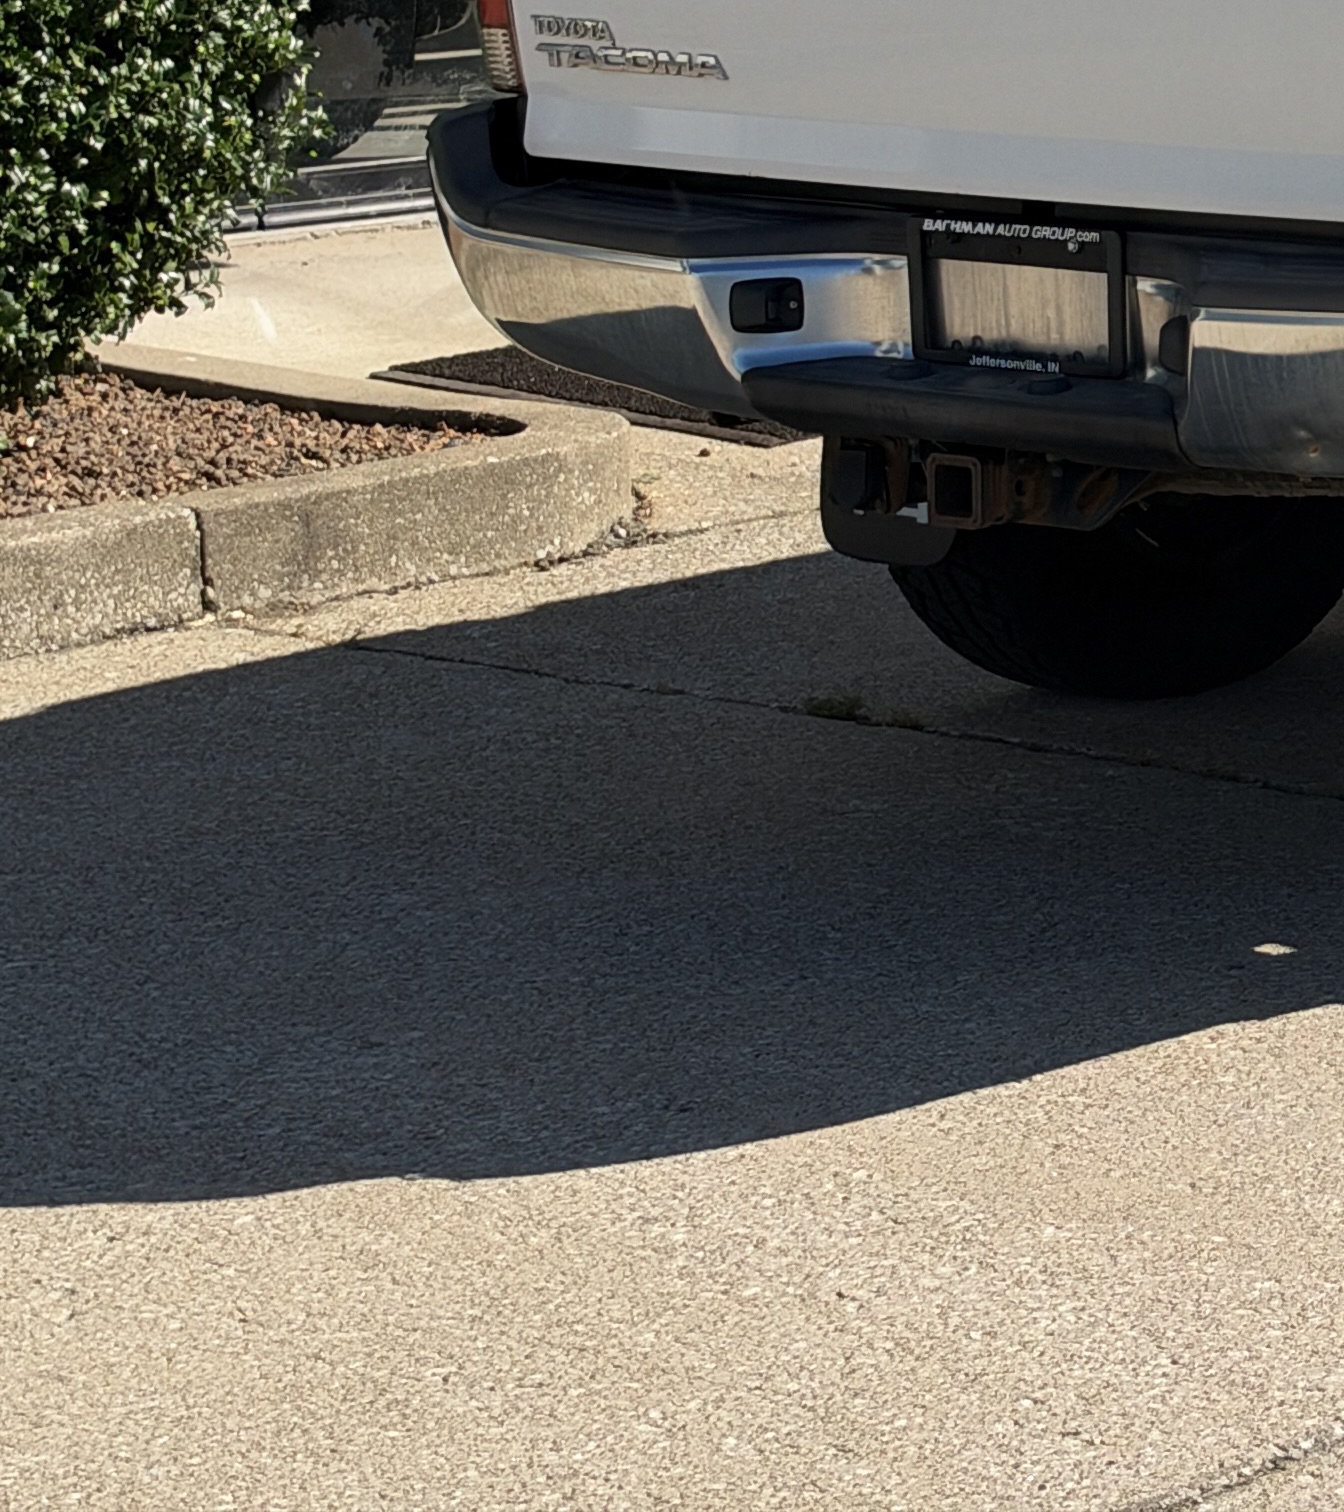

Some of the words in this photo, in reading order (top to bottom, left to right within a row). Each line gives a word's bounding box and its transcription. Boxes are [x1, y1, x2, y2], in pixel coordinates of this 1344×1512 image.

[530, 14, 616, 46] TOYOTA
[535, 42, 730, 81] TACOMA
[922, 218, 995, 235] BACHMAN
[995, 222, 1030, 238] AUTO
[1031, 225, 1101, 244] GROUP.com
[1047, 360, 1060, 374] IN
